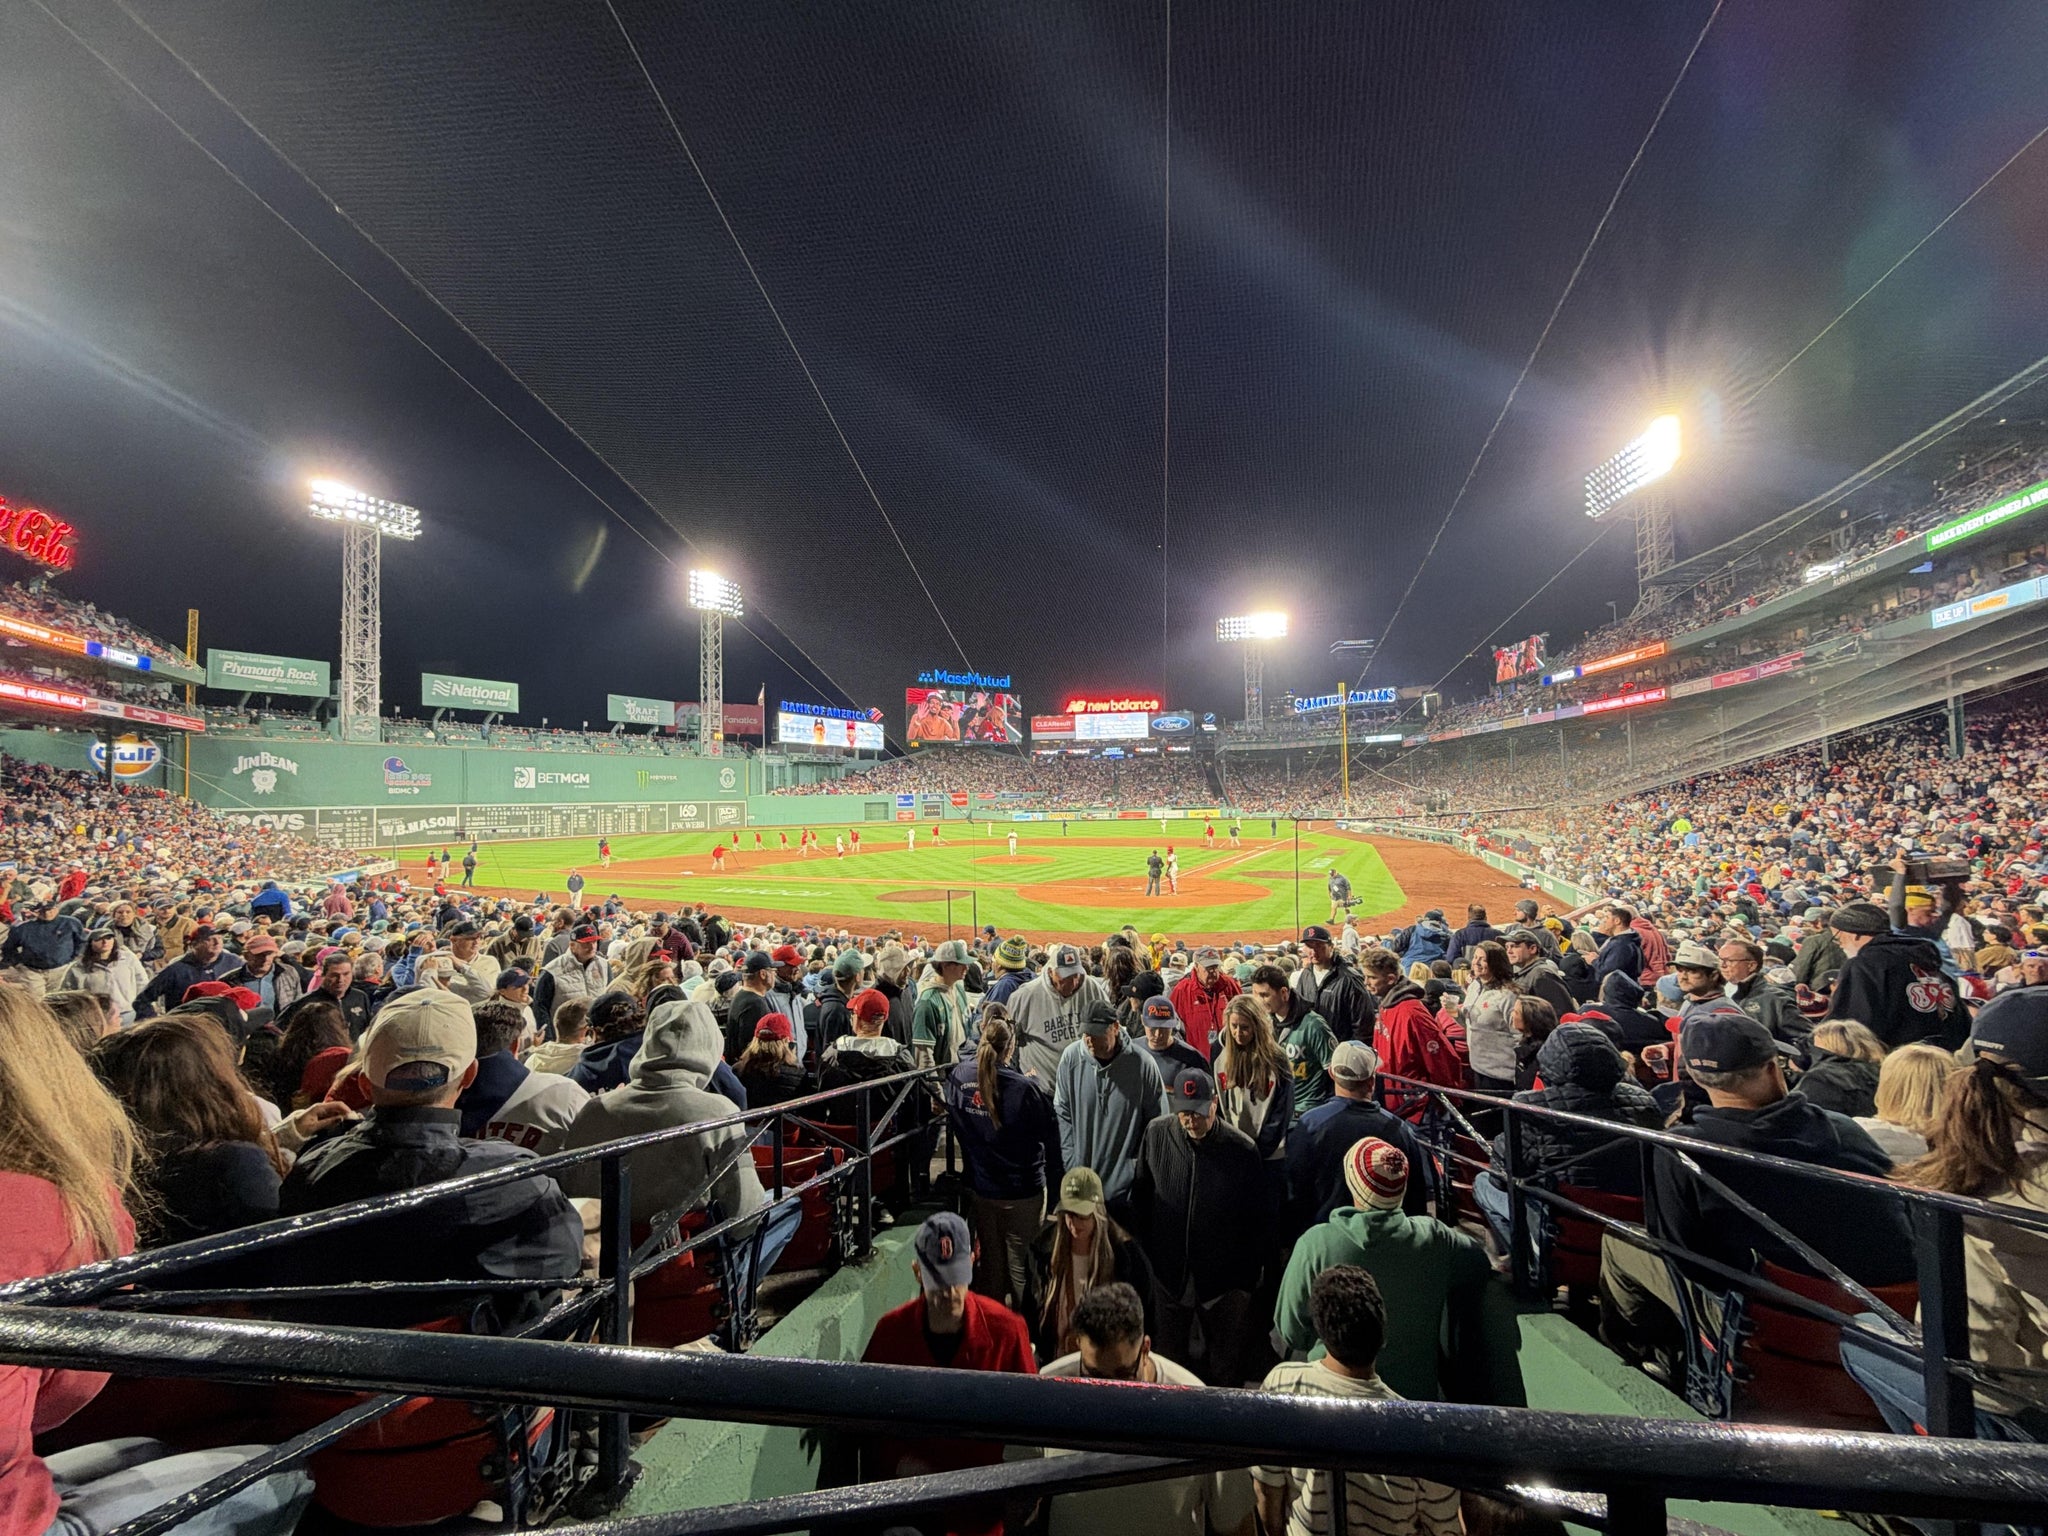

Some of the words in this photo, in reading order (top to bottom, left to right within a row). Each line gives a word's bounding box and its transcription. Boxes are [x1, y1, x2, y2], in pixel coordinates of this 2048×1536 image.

[1935, 610, 1952, 623] DUE
[1953, 606, 1964, 618] UP
[222, 661, 284, 678] Plymouth
[287, 667, 318, 681] Rock
[934, 669, 1010, 687] MassMutual
[451, 683, 511, 701] National
[1294, 693, 1346, 713] SAMUEL
[1347, 688, 1396, 704] ADAMS
[780, 700, 811, 714] BANK
[812, 704, 826, 715] OF
[826, 707, 867, 720] AMERICA
[1087, 702, 1110, 712] new
[1110, 698, 1159, 711] balance
[723, 715, 758, 724] Fanatics
[1159, 718, 1182, 729] Ford
[260, 751, 299, 776] BEAM
[538, 772, 590, 784] BETMGM
[252, 813, 305, 831] CVS
[1285, 1043, 1306, 1059] OX
[1183, 1079, 1196, 1095] C
